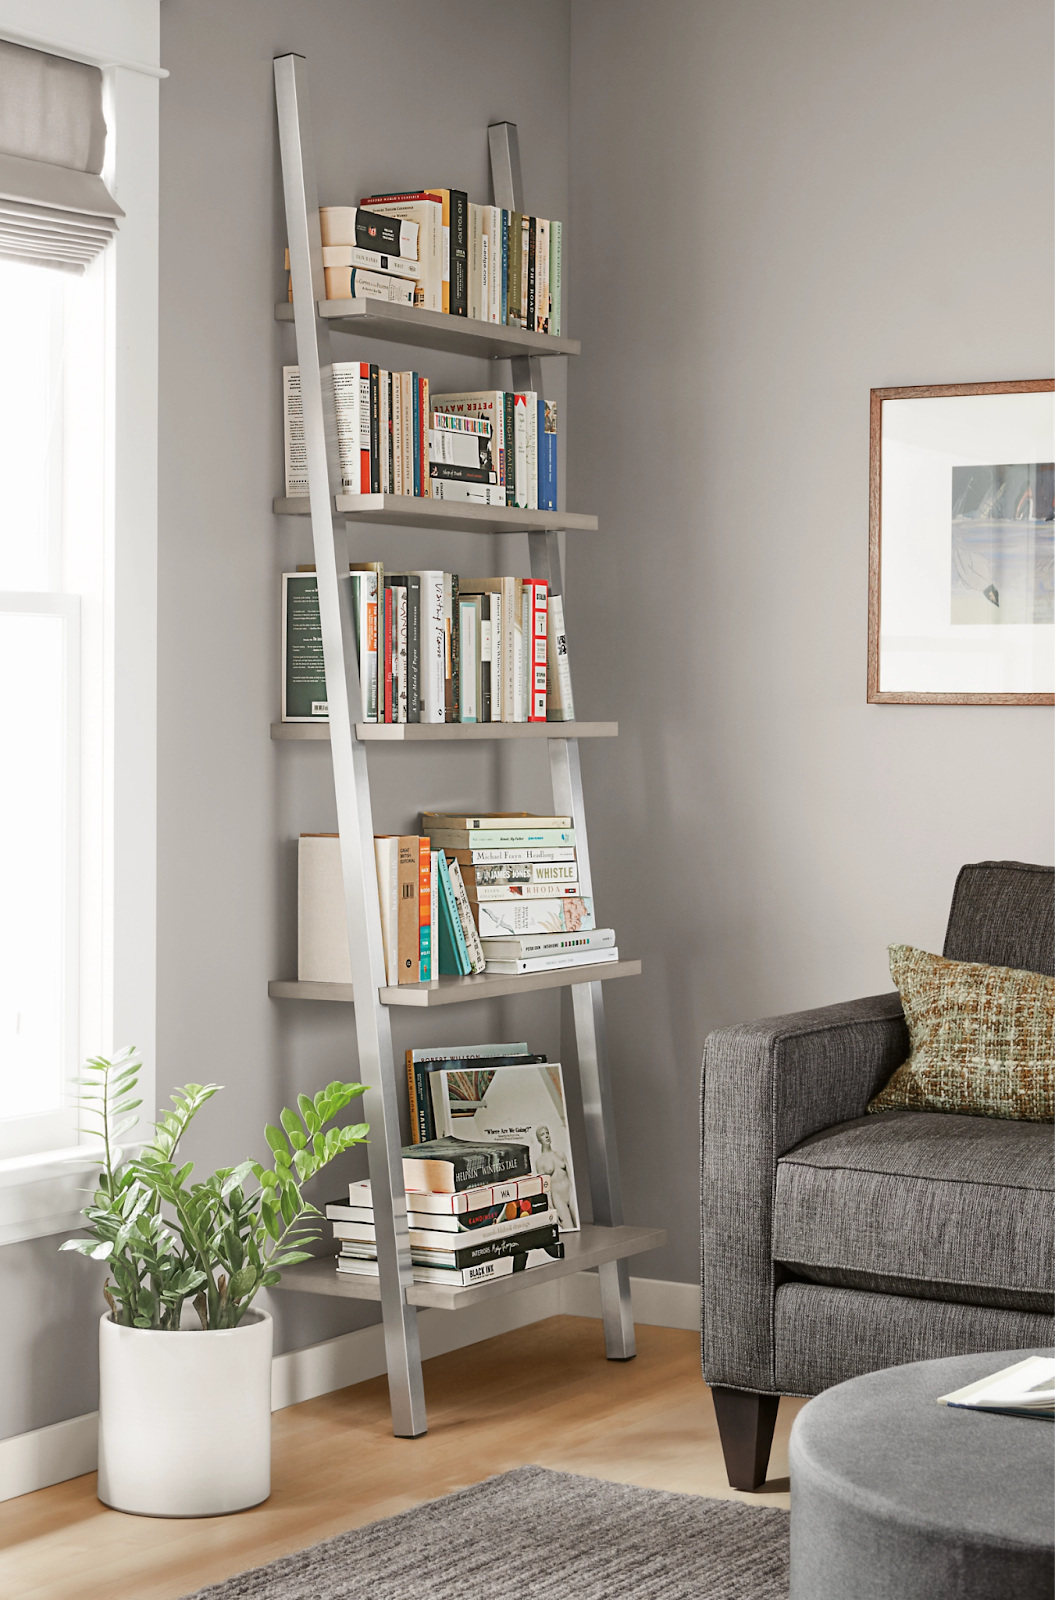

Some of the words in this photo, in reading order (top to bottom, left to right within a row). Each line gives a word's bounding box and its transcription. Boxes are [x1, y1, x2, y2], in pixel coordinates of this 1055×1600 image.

[434, 405, 463, 413] MAYLE
[467, 402, 493, 411] PETER
[432, 583, 442, 622] Visiting
[477, 852, 502, 860] Michael
[505, 851, 522, 861] Frayn
[526, 851, 554, 860] Headlong
[491, 870, 510, 879] JAMES
[512, 870, 531, 878] JONES
[536, 867, 573, 879] WHISTLE
[482, 1161, 505, 1175] WINTER'S
[506, 1159, 517, 1170] TALE
[456, 1168, 478, 1182] HELPRIN
[501, 1190, 510, 1198] WA
[468, 1212, 498, 1225] KANDINSKY
[513, 1222, 530, 1230] drawings
[471, 1246, 490, 1257] INTERIORS
[470, 1266, 484, 1278] BLACK
[486, 1264, 494, 1273] INK
